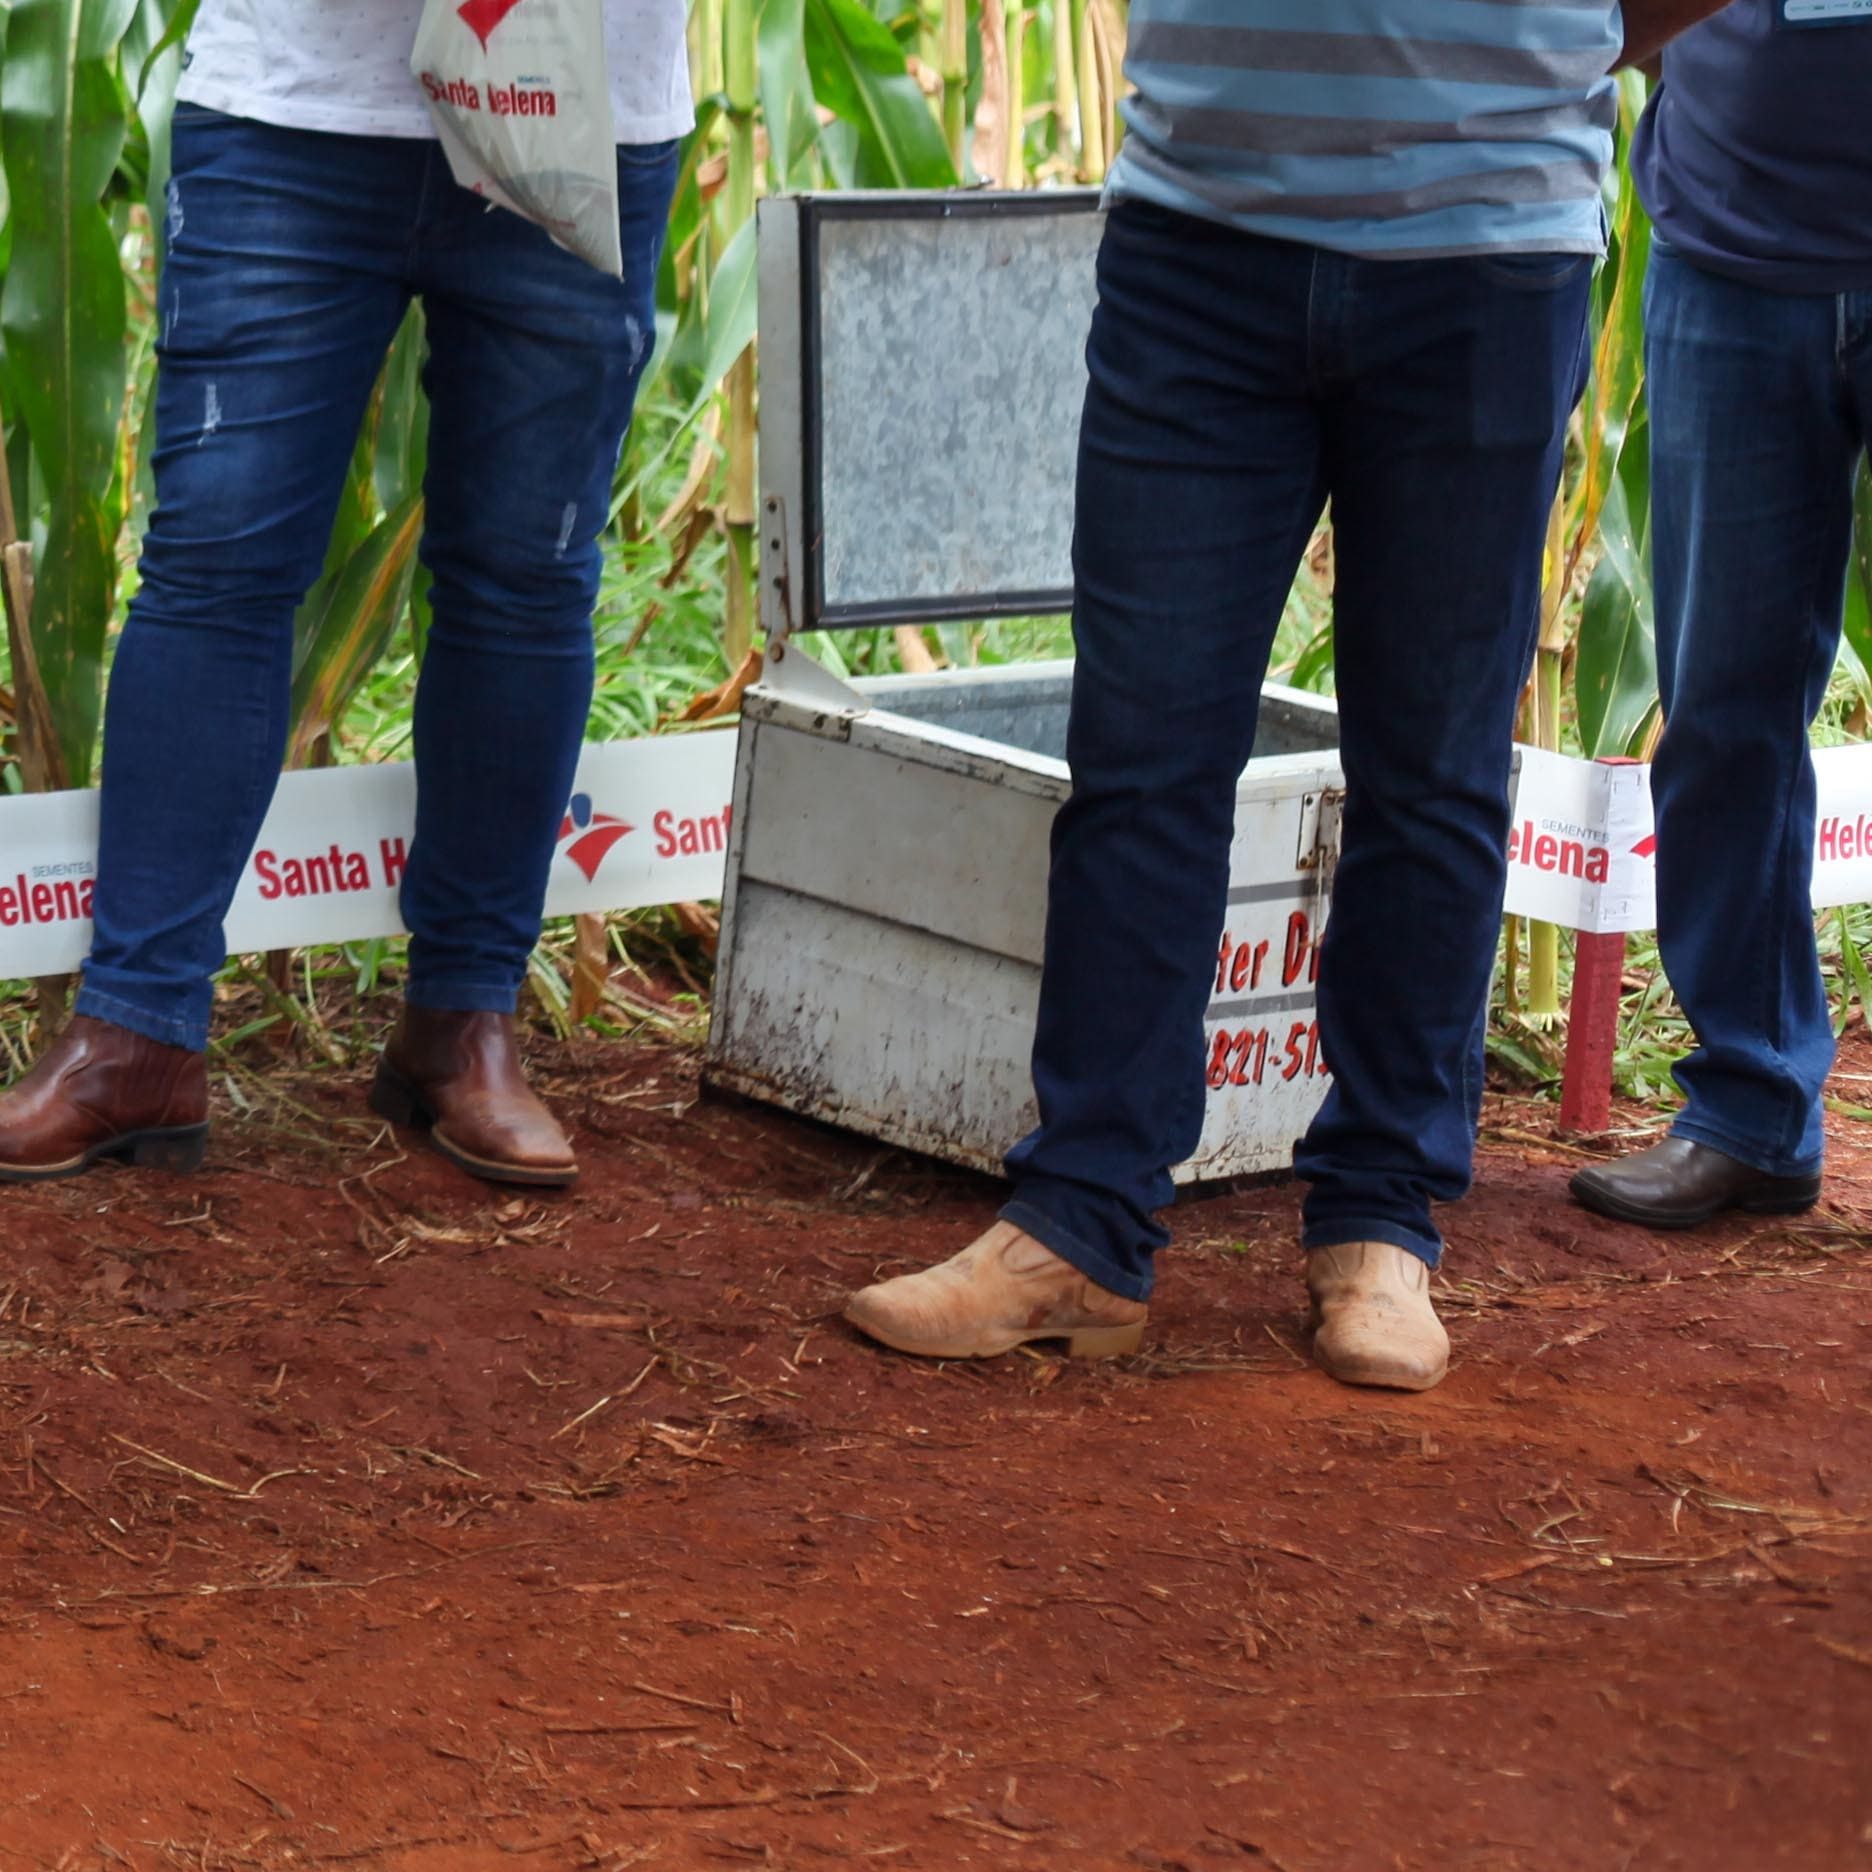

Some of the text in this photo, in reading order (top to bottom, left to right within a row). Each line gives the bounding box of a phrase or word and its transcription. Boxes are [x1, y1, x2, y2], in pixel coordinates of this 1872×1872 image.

[1541, 818, 1610, 844] SEMENTES
[1819, 815, 1872, 861] Hele
[254, 844, 371, 900] Santa
